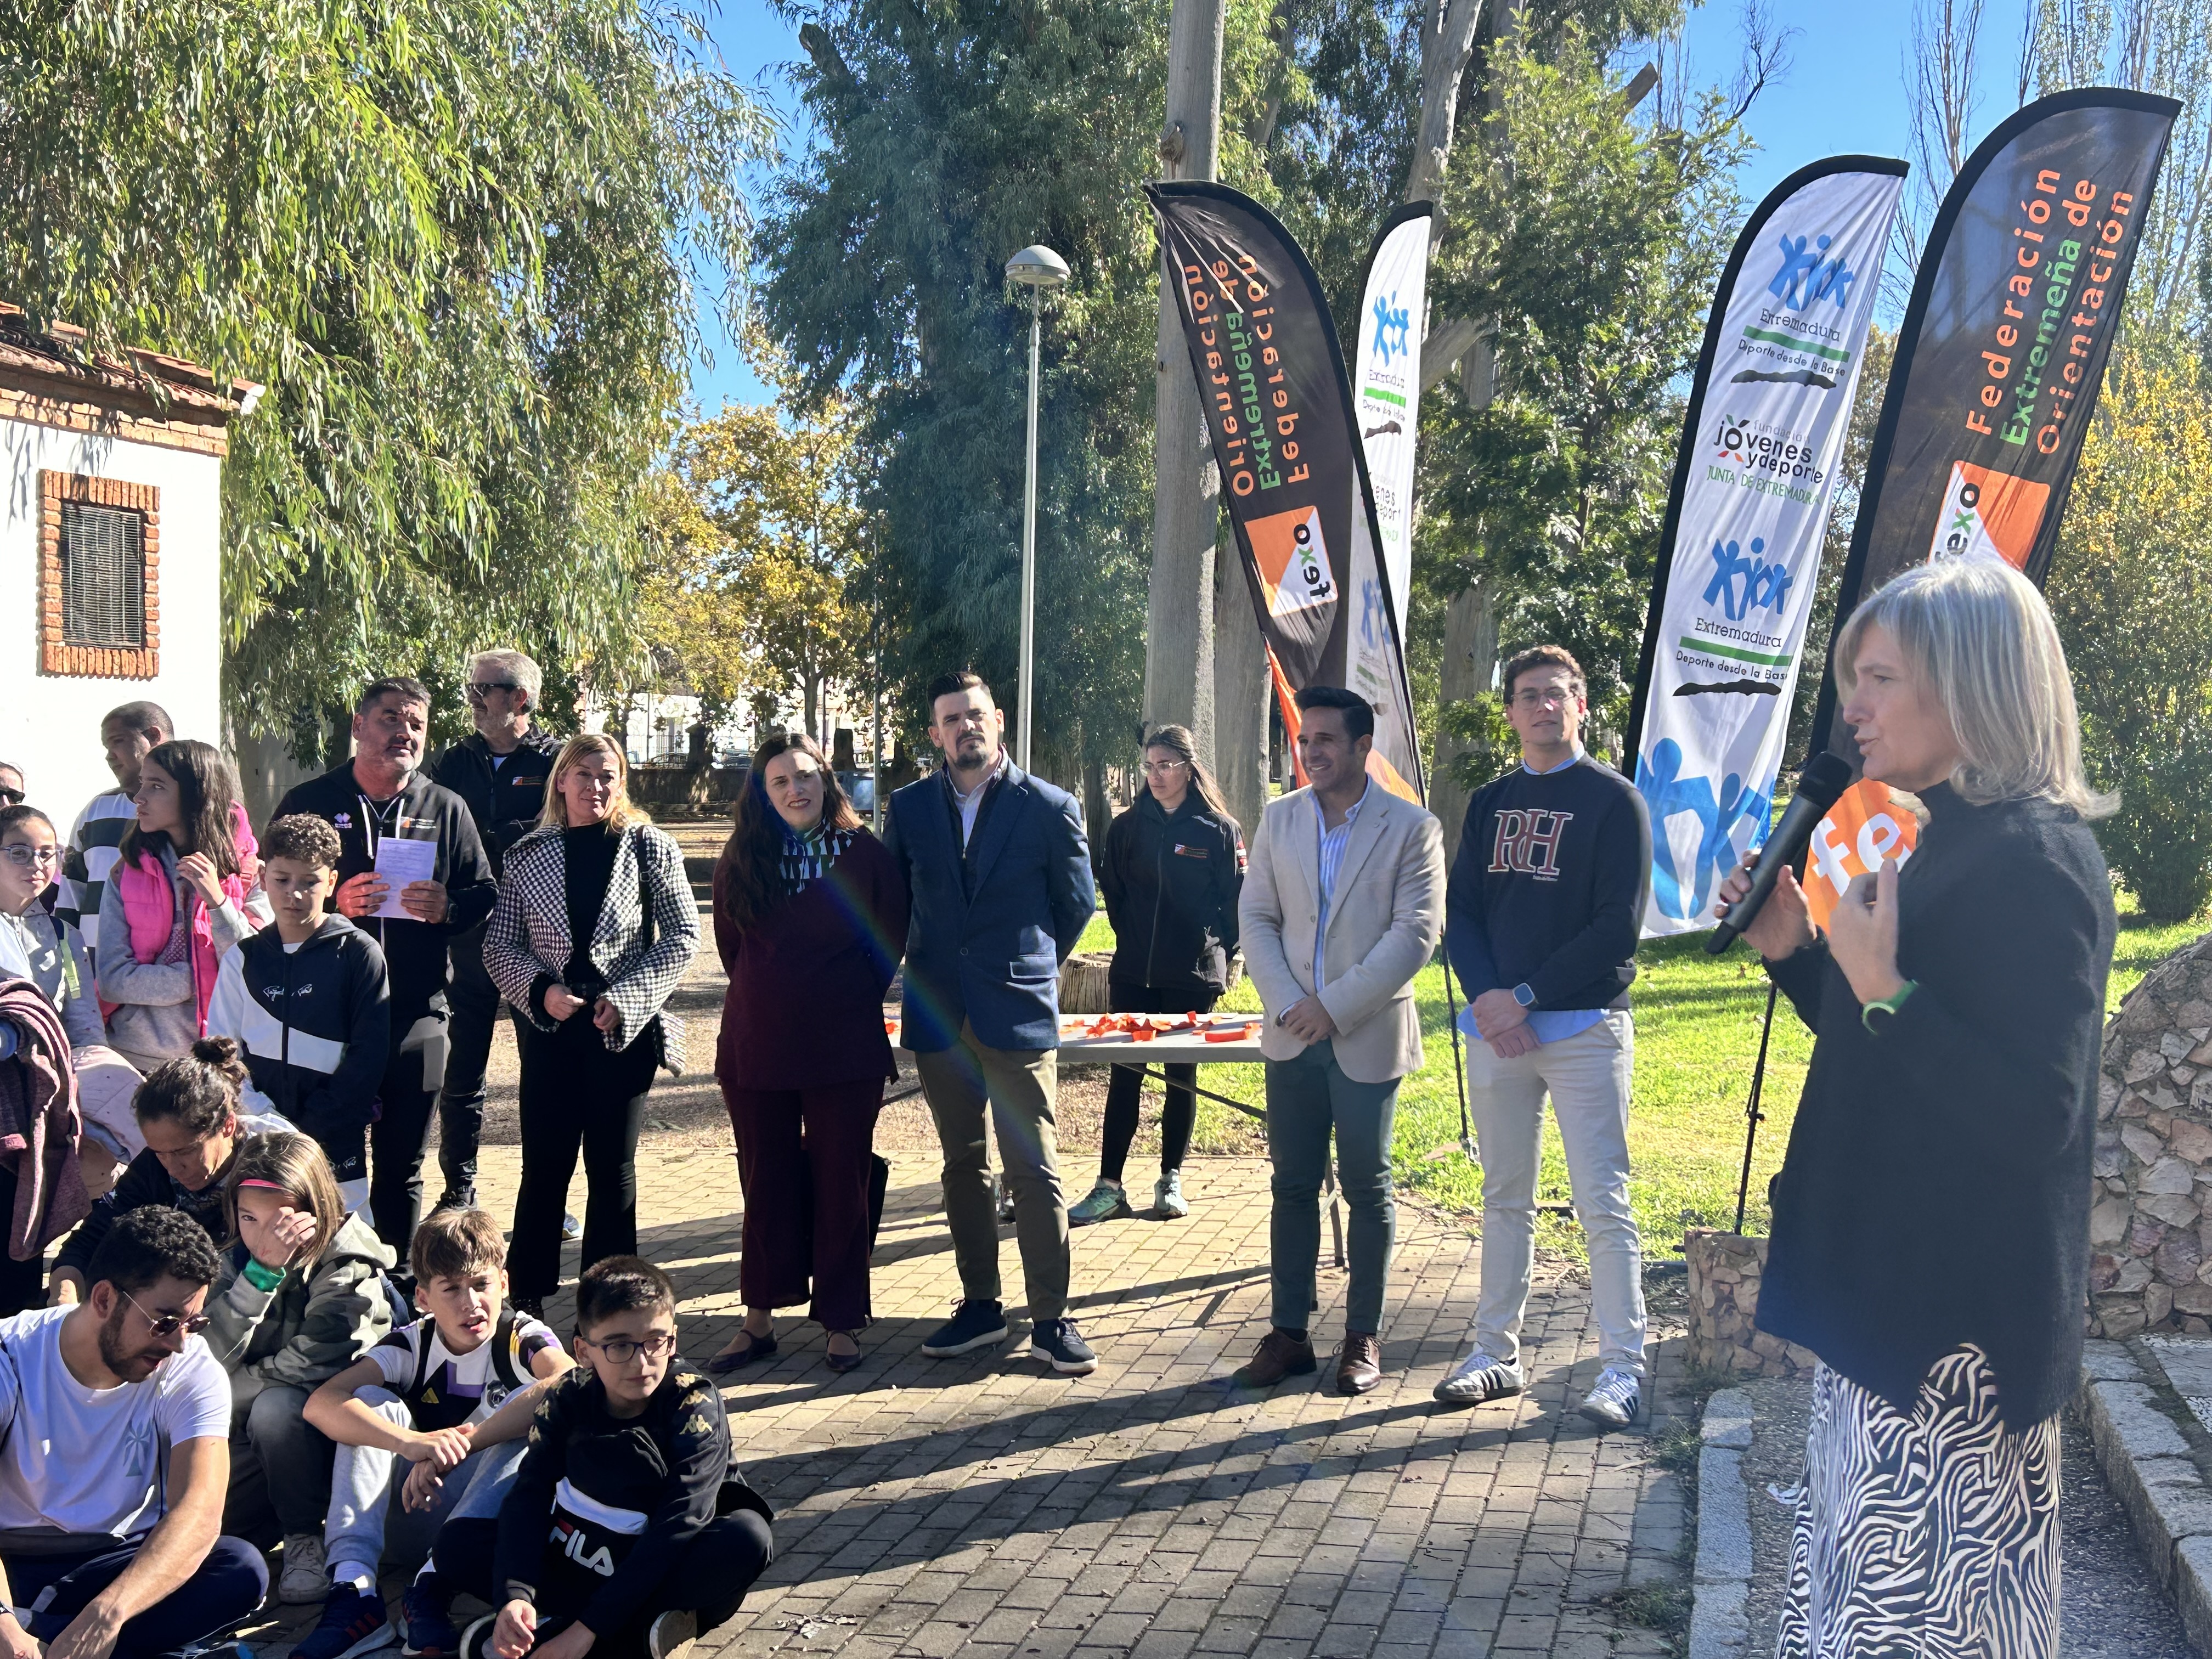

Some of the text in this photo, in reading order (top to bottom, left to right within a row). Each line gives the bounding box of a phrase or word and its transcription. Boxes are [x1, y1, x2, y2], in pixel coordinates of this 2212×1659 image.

[1966, 170, 2061, 435] Federación
[2000, 180, 2097, 445] Extremeña de
[2037, 191, 2133, 454] Orientación
[1777, 349, 1807, 366] desde
[1713, 419, 1813, 463] jóvenes
[1707, 465, 1735, 484] JUNTA
[1741, 473, 1754, 489] DE
[1695, 618, 1782, 647] Extremadura
[1676, 650, 1787, 680] Deporte desde la Bas
[549, 1518, 614, 1577] FILA
